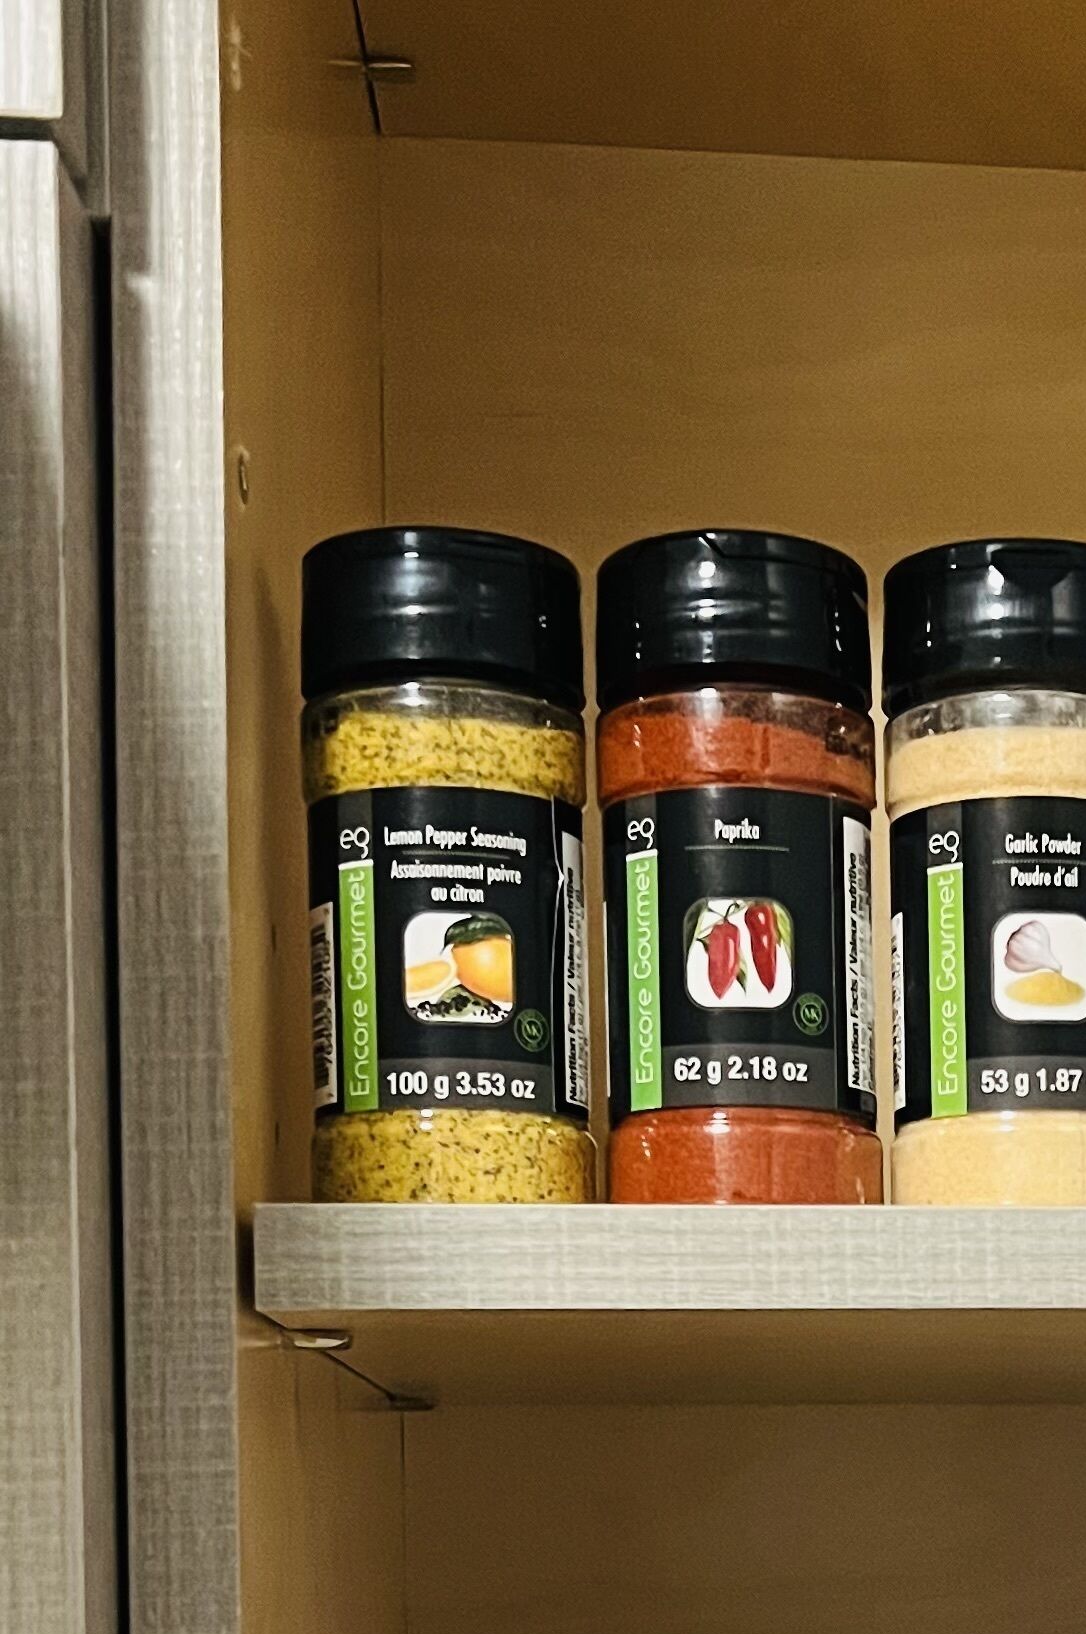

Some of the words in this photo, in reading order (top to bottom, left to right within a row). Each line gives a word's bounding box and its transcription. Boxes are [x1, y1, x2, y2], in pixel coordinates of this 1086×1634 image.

[384, 826, 423, 846] Lemon
[425, 824, 468, 849] Pepper
[471, 826, 527, 856] Seasoning
[714, 818, 761, 844] Paprika
[1005, 833, 1039, 855] Garlic
[1041, 834, 1082, 856] Powder
[390, 859, 484, 880] Assaisonnement
[487, 864, 522, 885] poivre
[1010, 866, 1052, 888] Poudre
[430, 887, 448, 902] au
[450, 883, 485, 903] citron
[346, 869, 367, 991] Gourmet
[632, 862, 653, 981] Gourmet
[934, 873, 956, 992] Gourmet
[349, 997, 370, 1096] Encore
[635, 987, 655, 1085] Encore
[937, 1000, 959, 1095] Encore
[673, 1056, 702, 1081] 62
[707, 1062, 722, 1085] g
[728, 1056, 779, 1081] 2.18
[783, 1061, 809, 1083] oz
[980, 1069, 1009, 1094] 53
[1015, 1074, 1030, 1097] g
[1036, 1069, 1083, 1093] 1.87
[387, 1072, 428, 1096] 100
[434, 1075, 450, 1099] g
[456, 1072, 506, 1097] 3.53
[511, 1076, 536, 1099] oz
